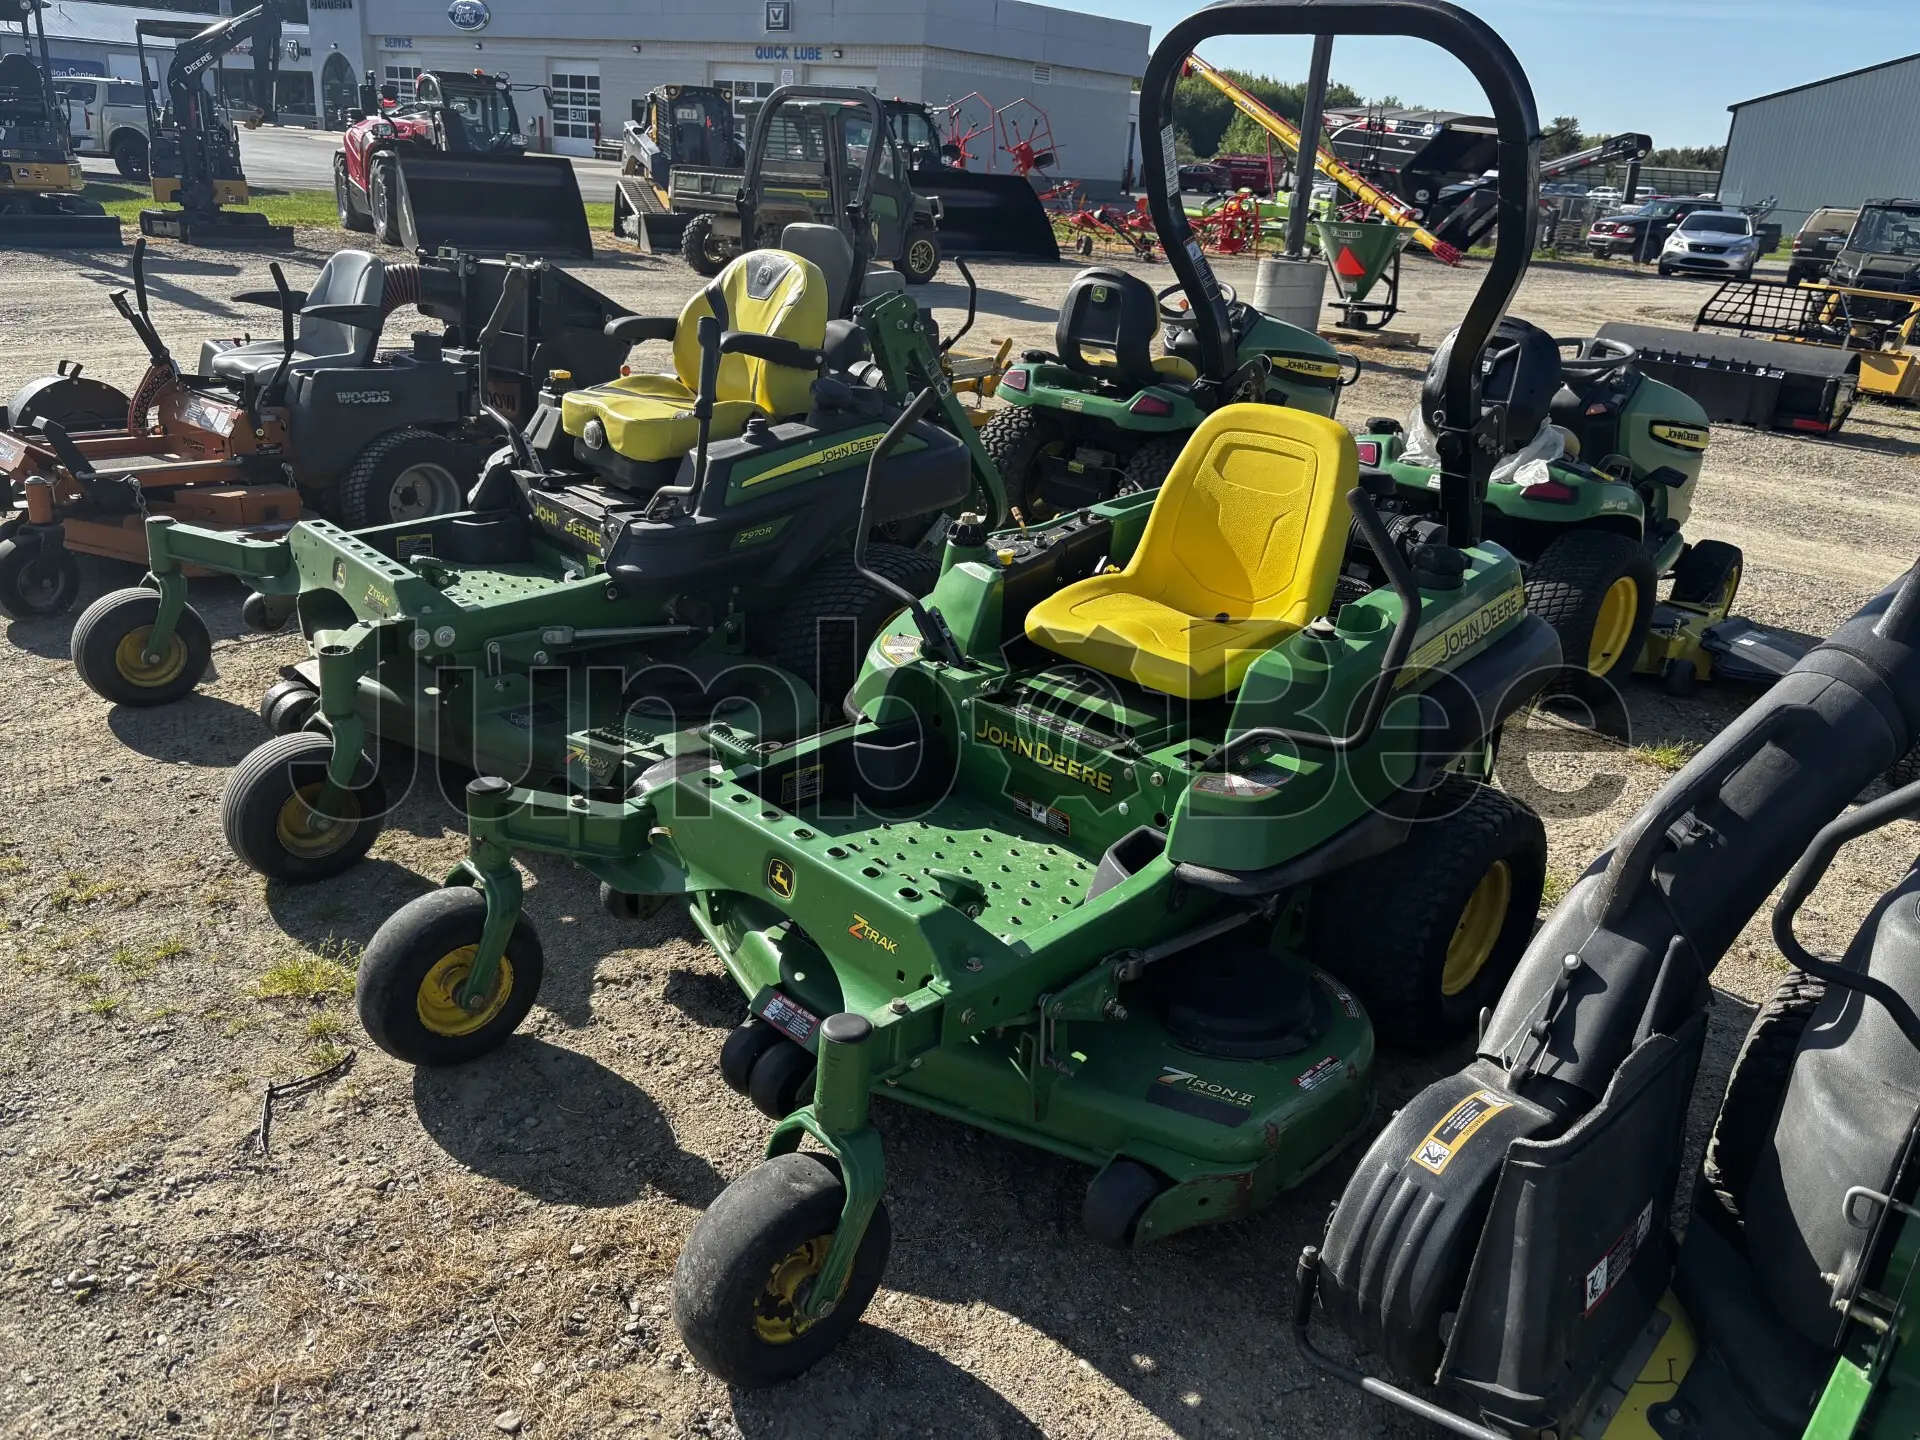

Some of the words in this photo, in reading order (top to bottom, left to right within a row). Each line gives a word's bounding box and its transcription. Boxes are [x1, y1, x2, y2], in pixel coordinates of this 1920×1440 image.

[454, 5, 476, 24] Ford
[384, 36, 413, 49] SERVICE
[755, 46, 788, 60] QUICK
[794, 47, 823, 60] LUBE
[184, 52, 213, 75] DEERE
[571, 110, 587, 121] EXIT
[336, 391, 391, 404] WOODS
[820, 447, 850, 464] JOHN
[1441, 619, 1480, 659] JOHN
[1480, 593, 1518, 633] DEERE
[977, 719, 1033, 759] JOHN
[1034, 741, 1113, 795] DEERE
[848, 912, 898, 955] ZTRAK
